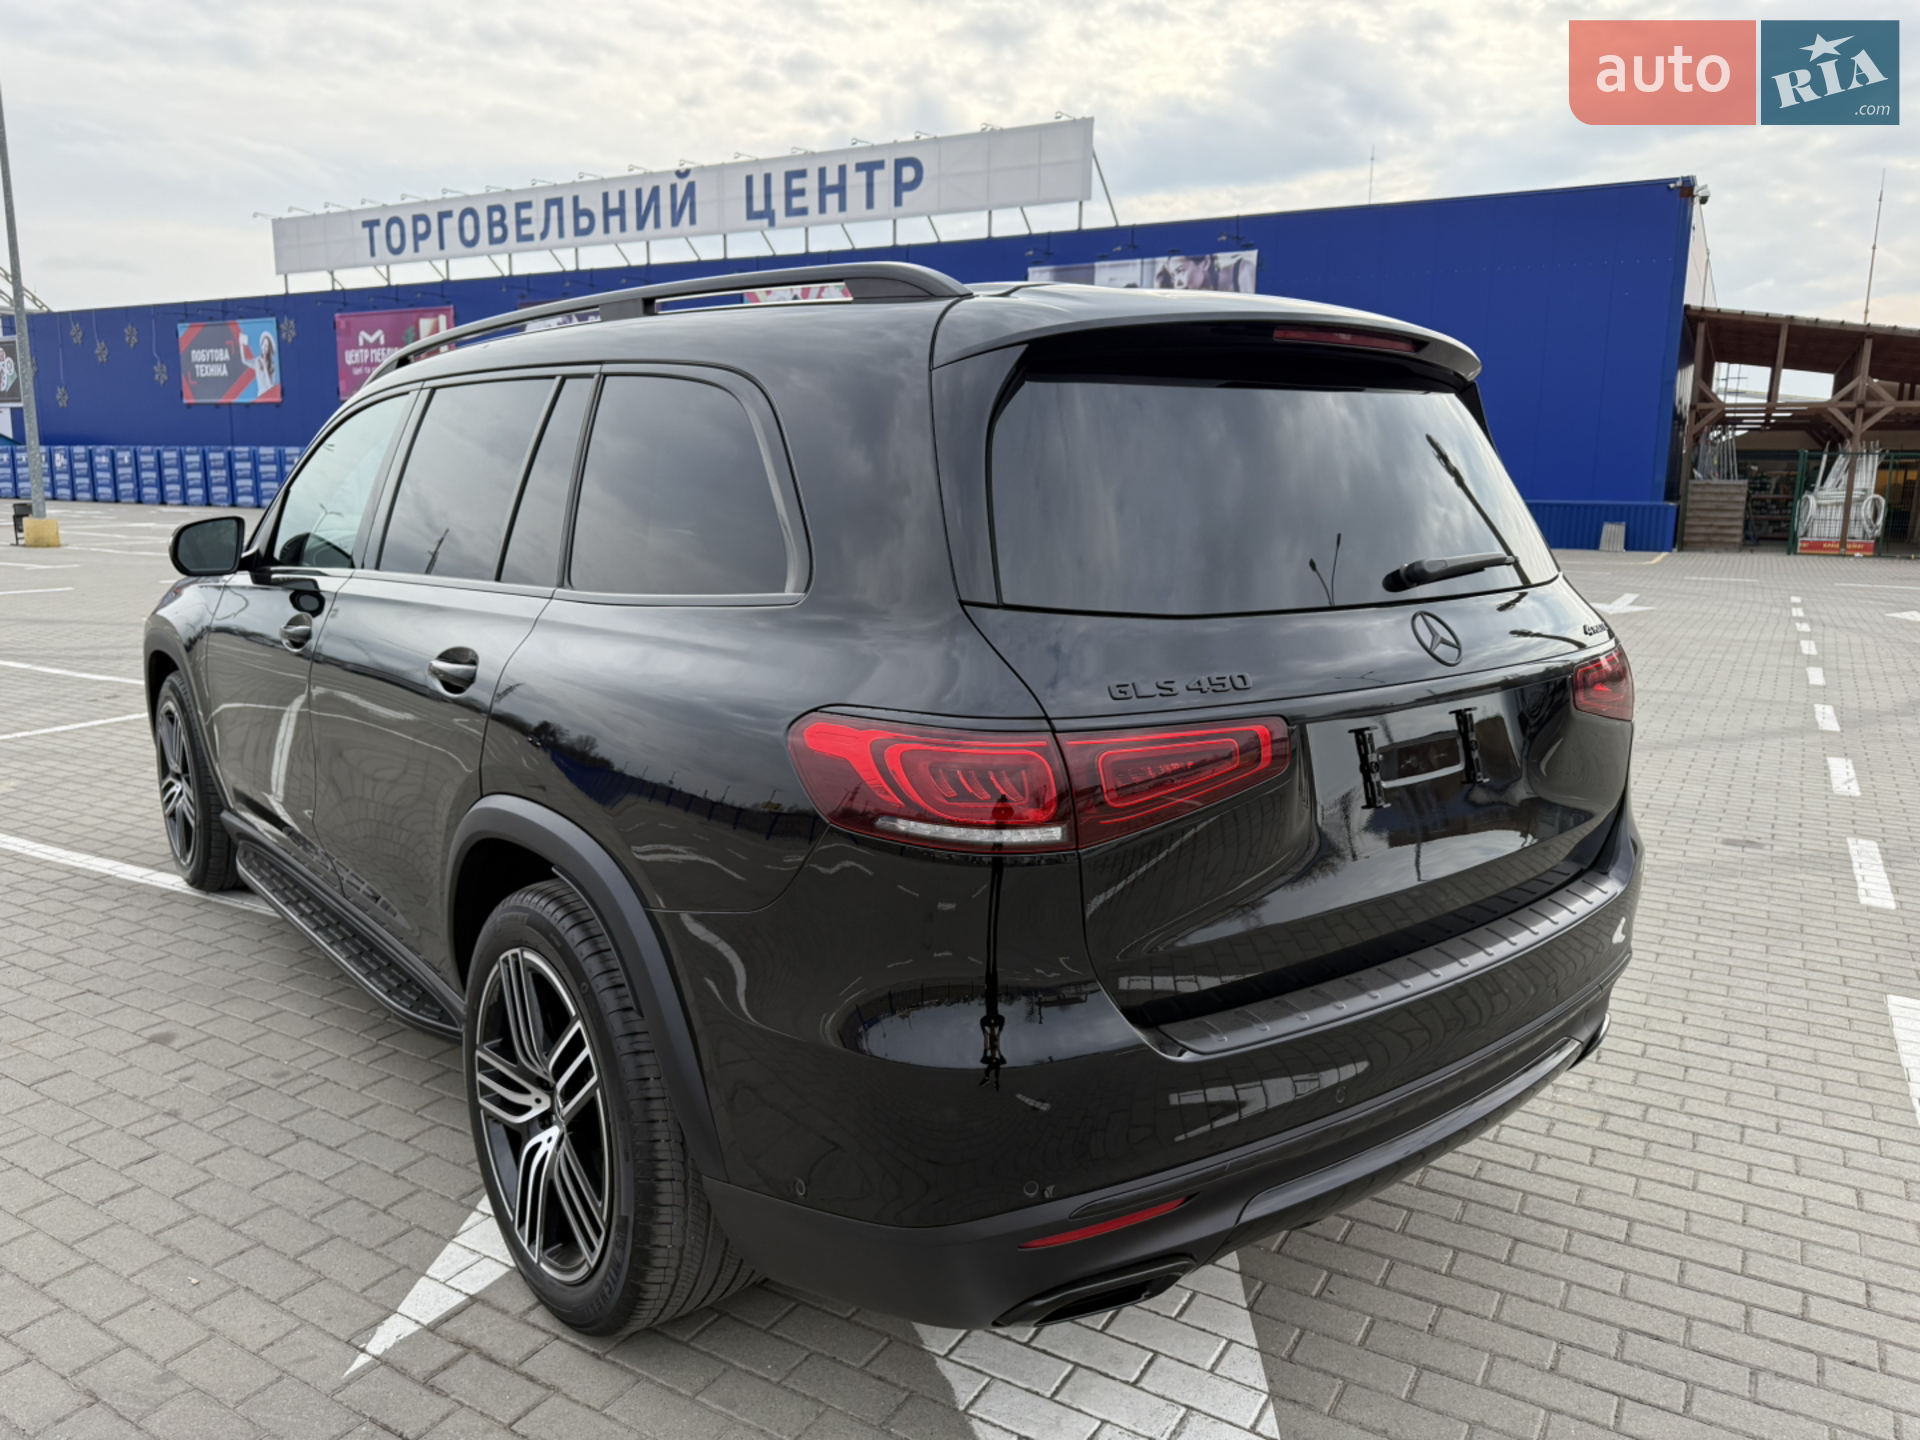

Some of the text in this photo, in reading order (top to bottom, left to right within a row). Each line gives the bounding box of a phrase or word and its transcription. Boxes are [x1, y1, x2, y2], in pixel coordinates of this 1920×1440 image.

[361, 155, 925, 258] ТОРГОВЕЛЬНИЙ ЦЕНТР
[191, 348, 230, 363] ПОБУТОВА
[344, 348, 369, 366] ЦЕНТР
[194, 363, 229, 378] ТЕХНІКА
[1107, 672, 1253, 701] GLS 450
